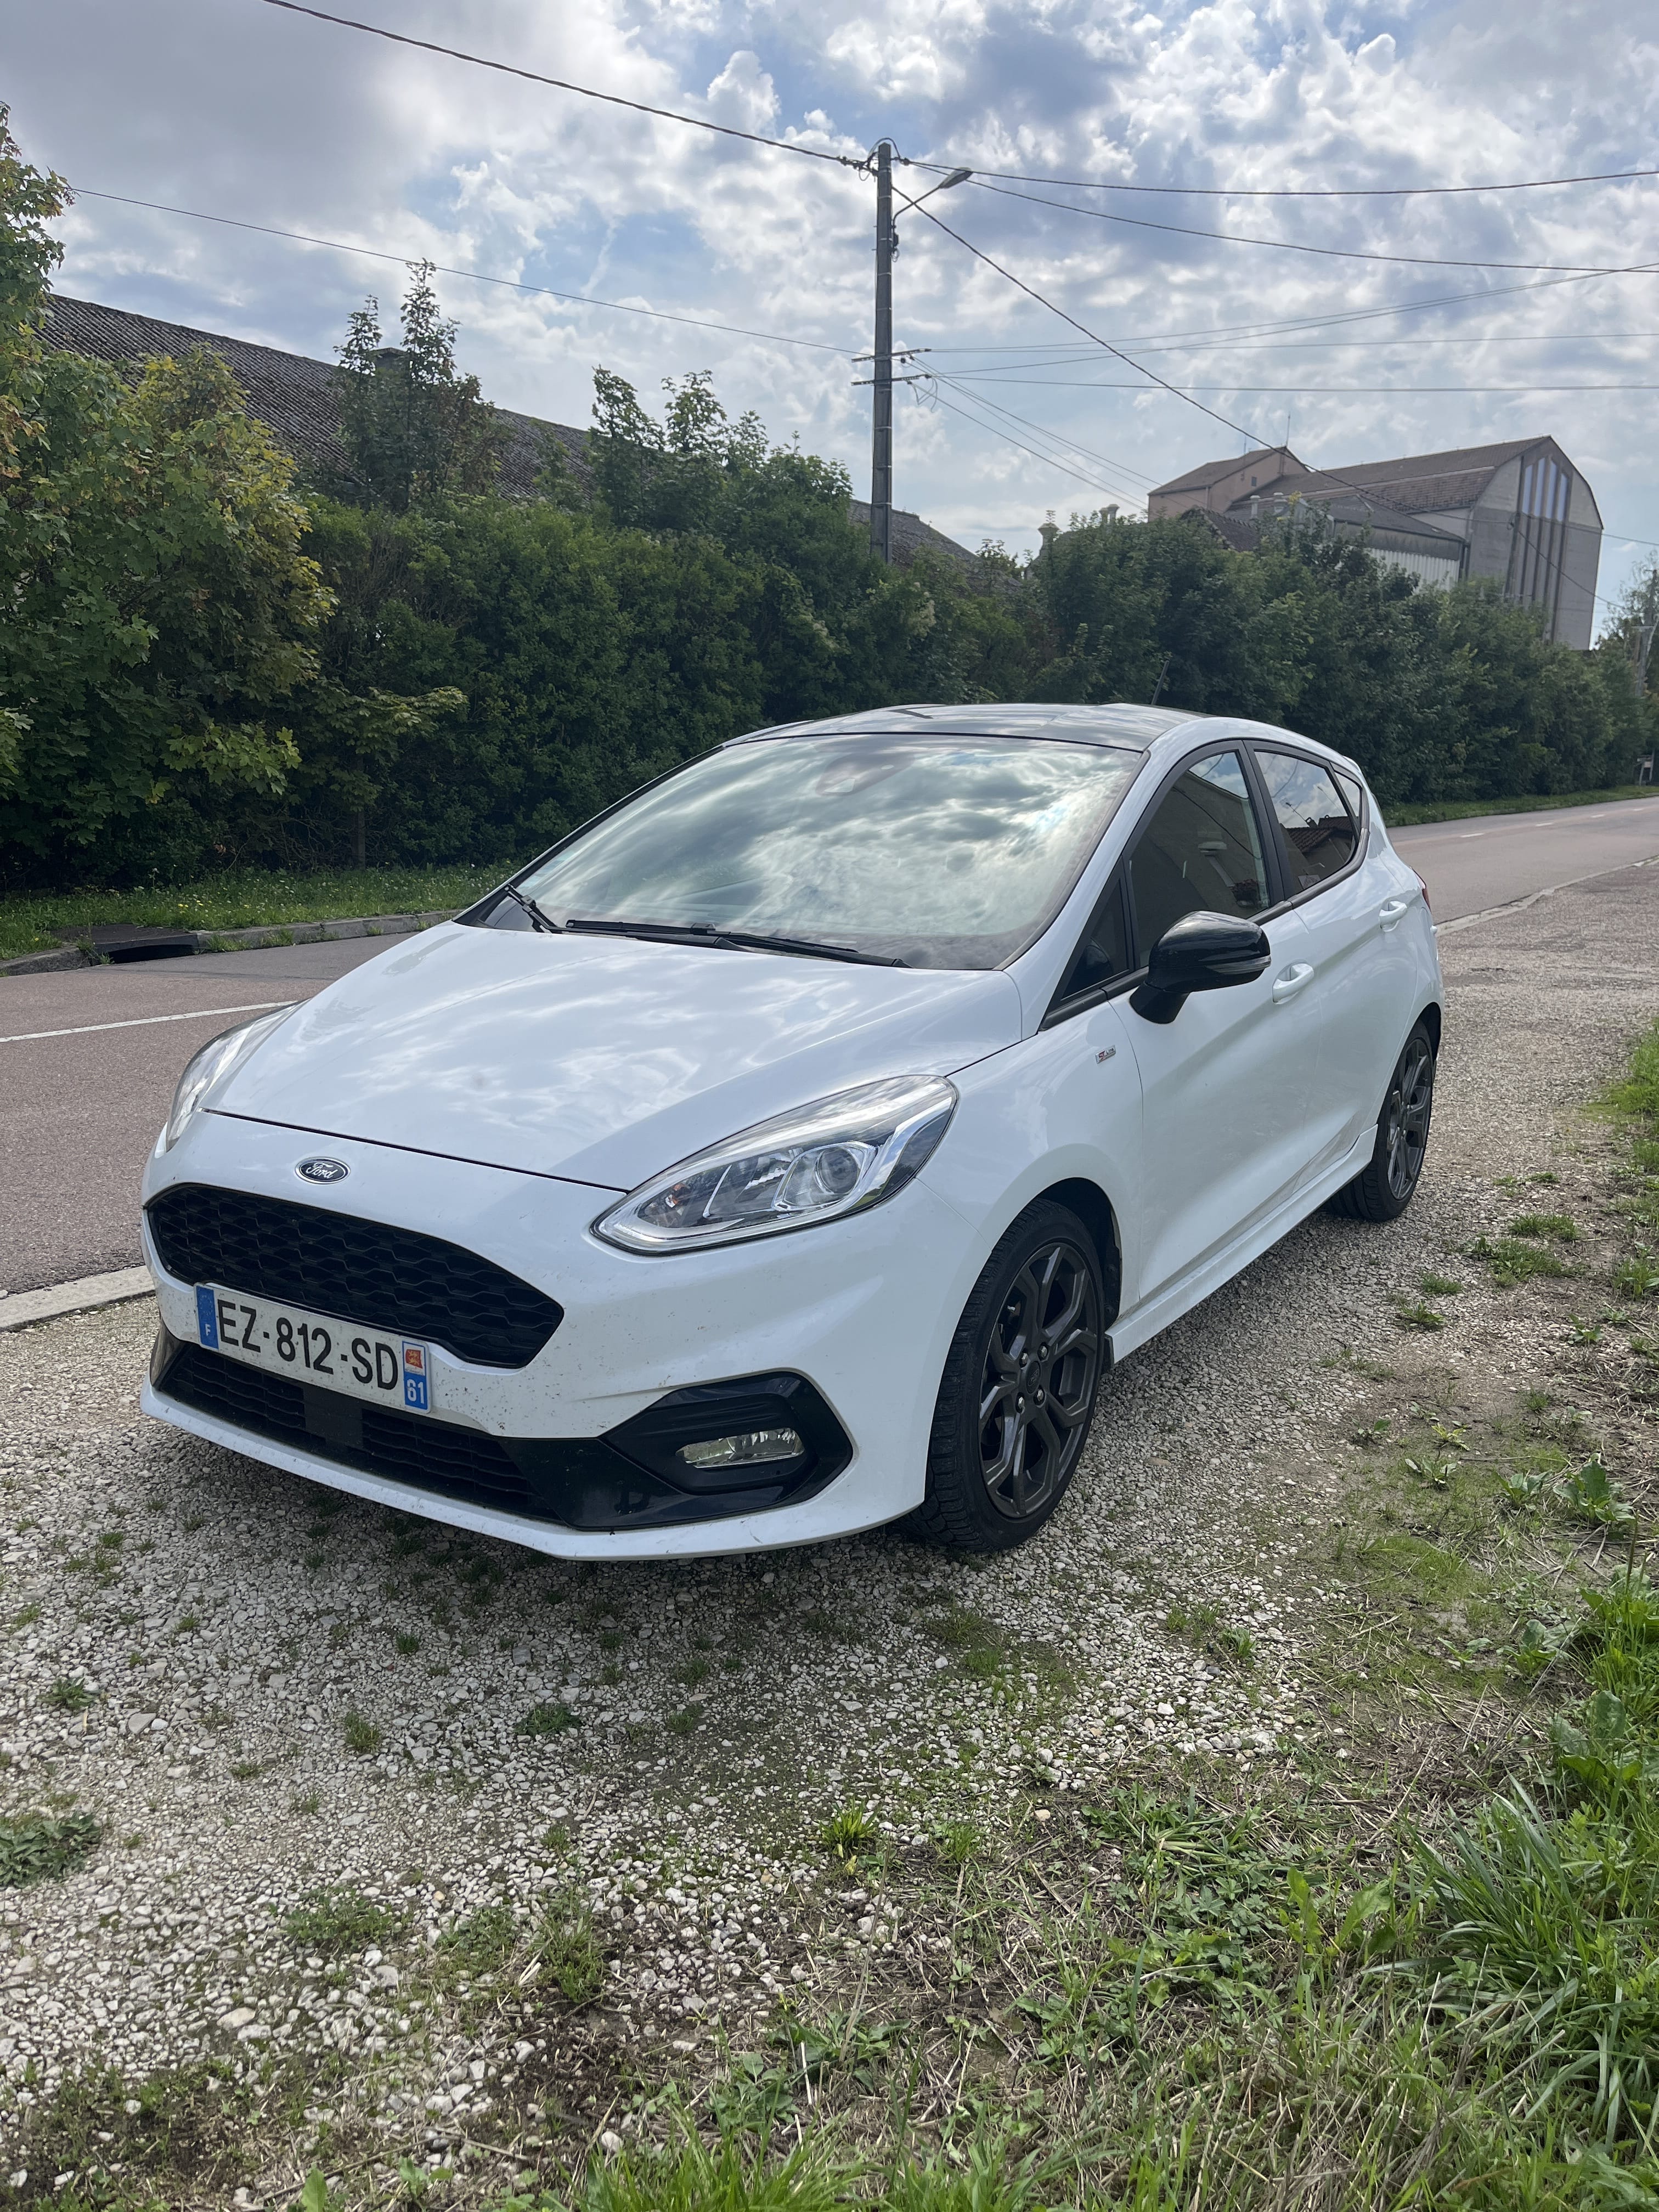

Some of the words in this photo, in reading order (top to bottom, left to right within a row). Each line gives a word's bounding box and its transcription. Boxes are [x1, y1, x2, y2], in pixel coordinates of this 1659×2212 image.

[306, 1162, 338, 1179] Ford
[205, 1323, 211, 1336] F
[217, 1299, 398, 1390] EZ-812-SD
[407, 1379, 425, 1404] 61
